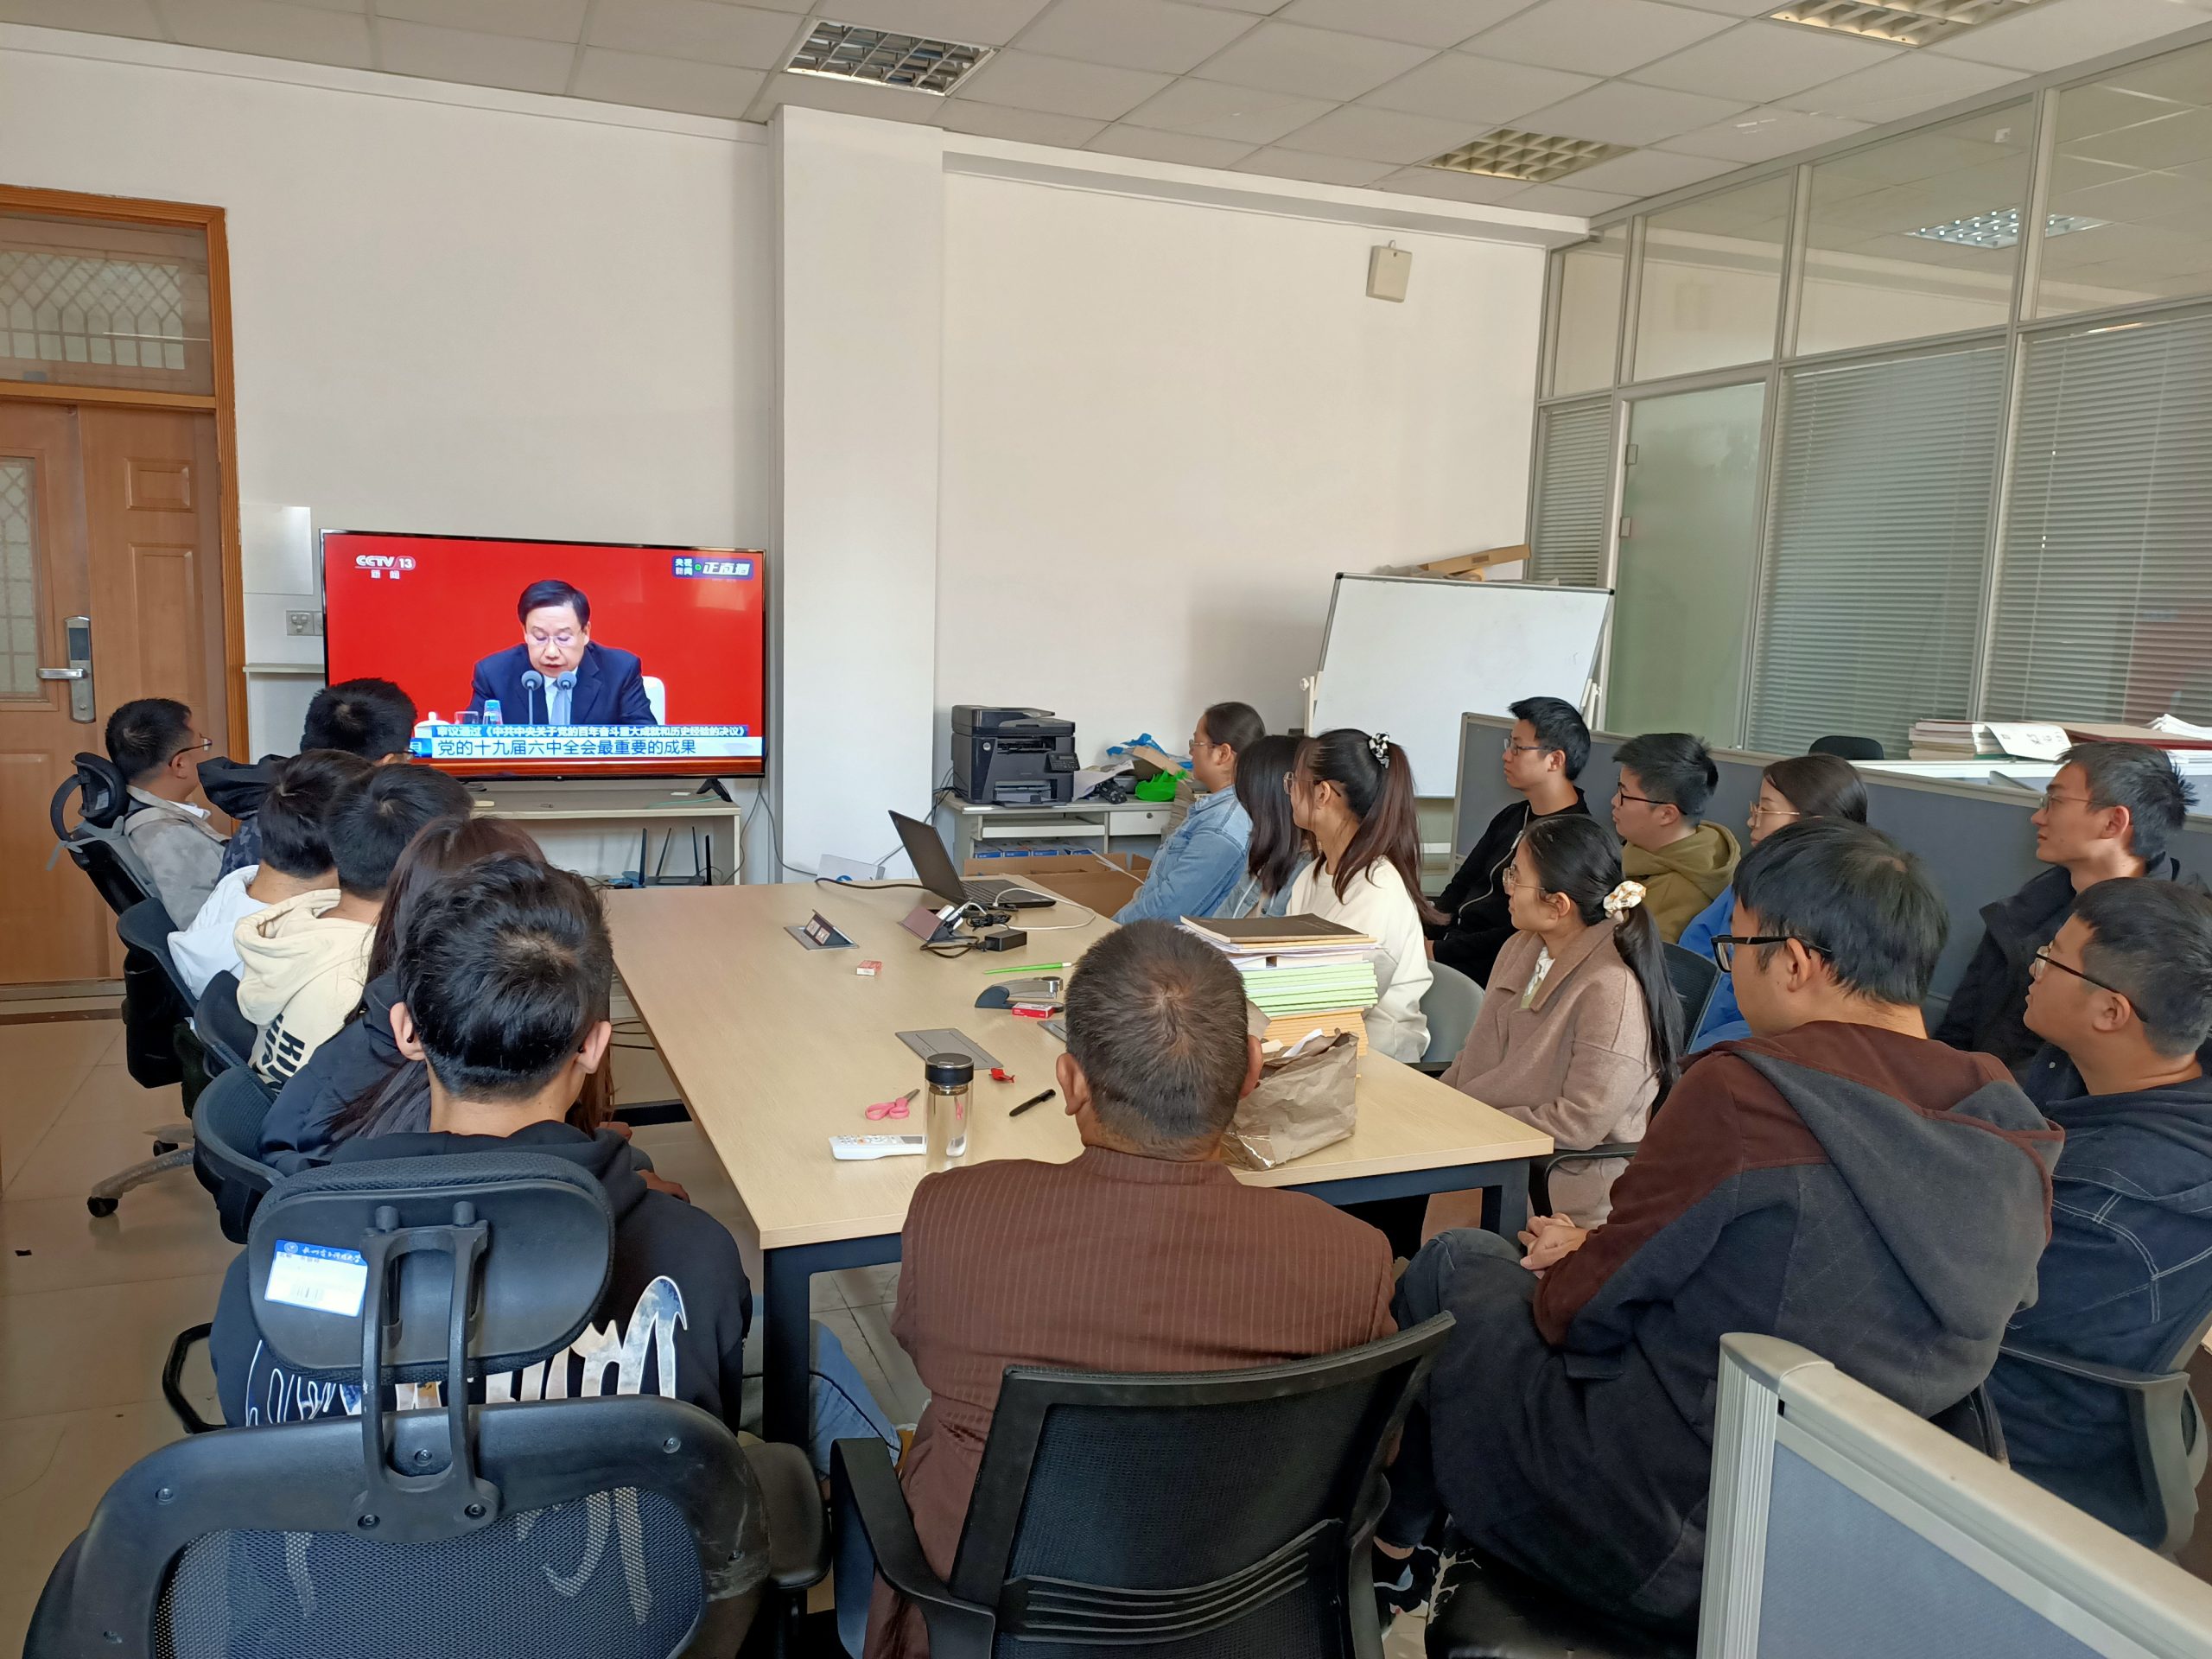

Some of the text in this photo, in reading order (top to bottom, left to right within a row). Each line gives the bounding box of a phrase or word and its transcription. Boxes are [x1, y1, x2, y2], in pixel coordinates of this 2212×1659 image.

[356, 555, 413, 569] CCTV 13
[437, 740, 696, 755] 党的十九届六中全会最重要的成果
